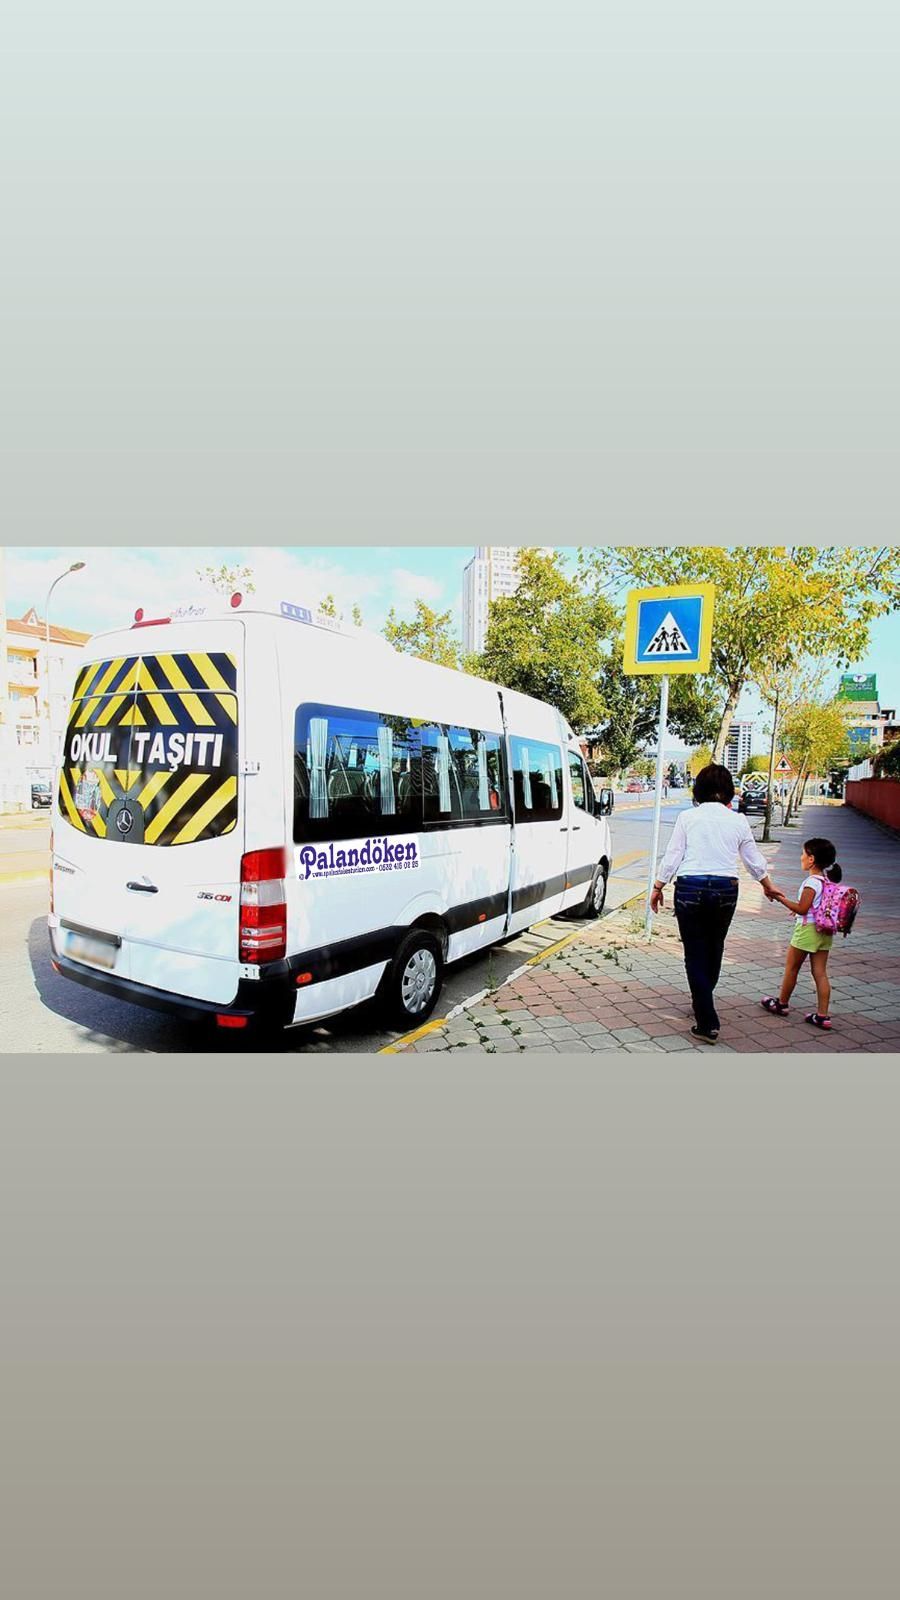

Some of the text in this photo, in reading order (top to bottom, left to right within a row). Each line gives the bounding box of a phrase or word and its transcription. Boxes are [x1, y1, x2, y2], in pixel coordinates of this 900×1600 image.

[70, 732, 224, 772] OKUL TAŞITI
[300, 837, 418, 880] Palandöken
